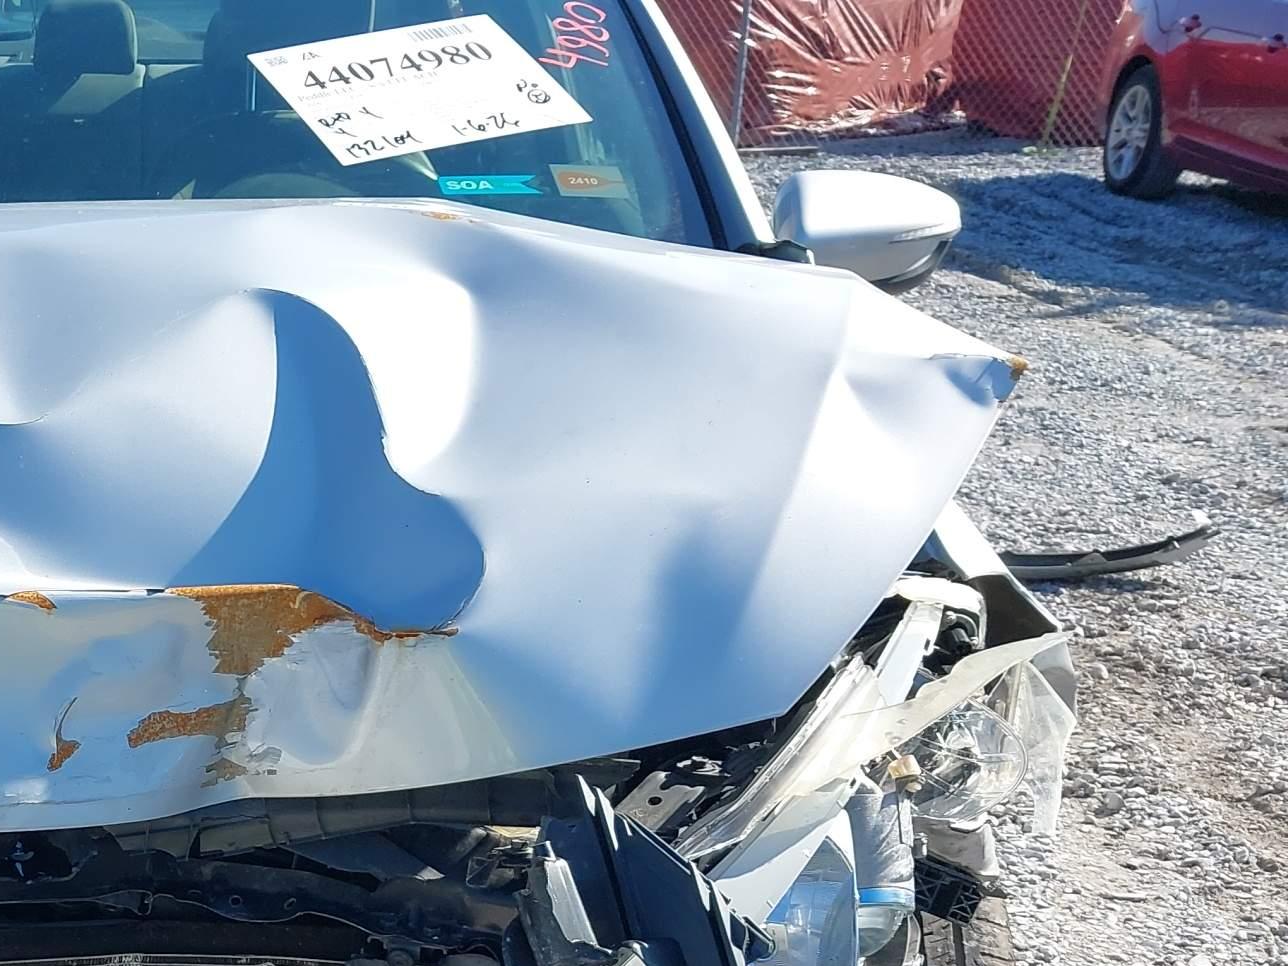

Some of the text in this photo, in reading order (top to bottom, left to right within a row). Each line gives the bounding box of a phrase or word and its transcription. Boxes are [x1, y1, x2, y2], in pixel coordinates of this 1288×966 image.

[537, 1, 610, 69] 4980
[304, 41, 492, 89] 44074980
[446, 180, 493, 190] SOA
